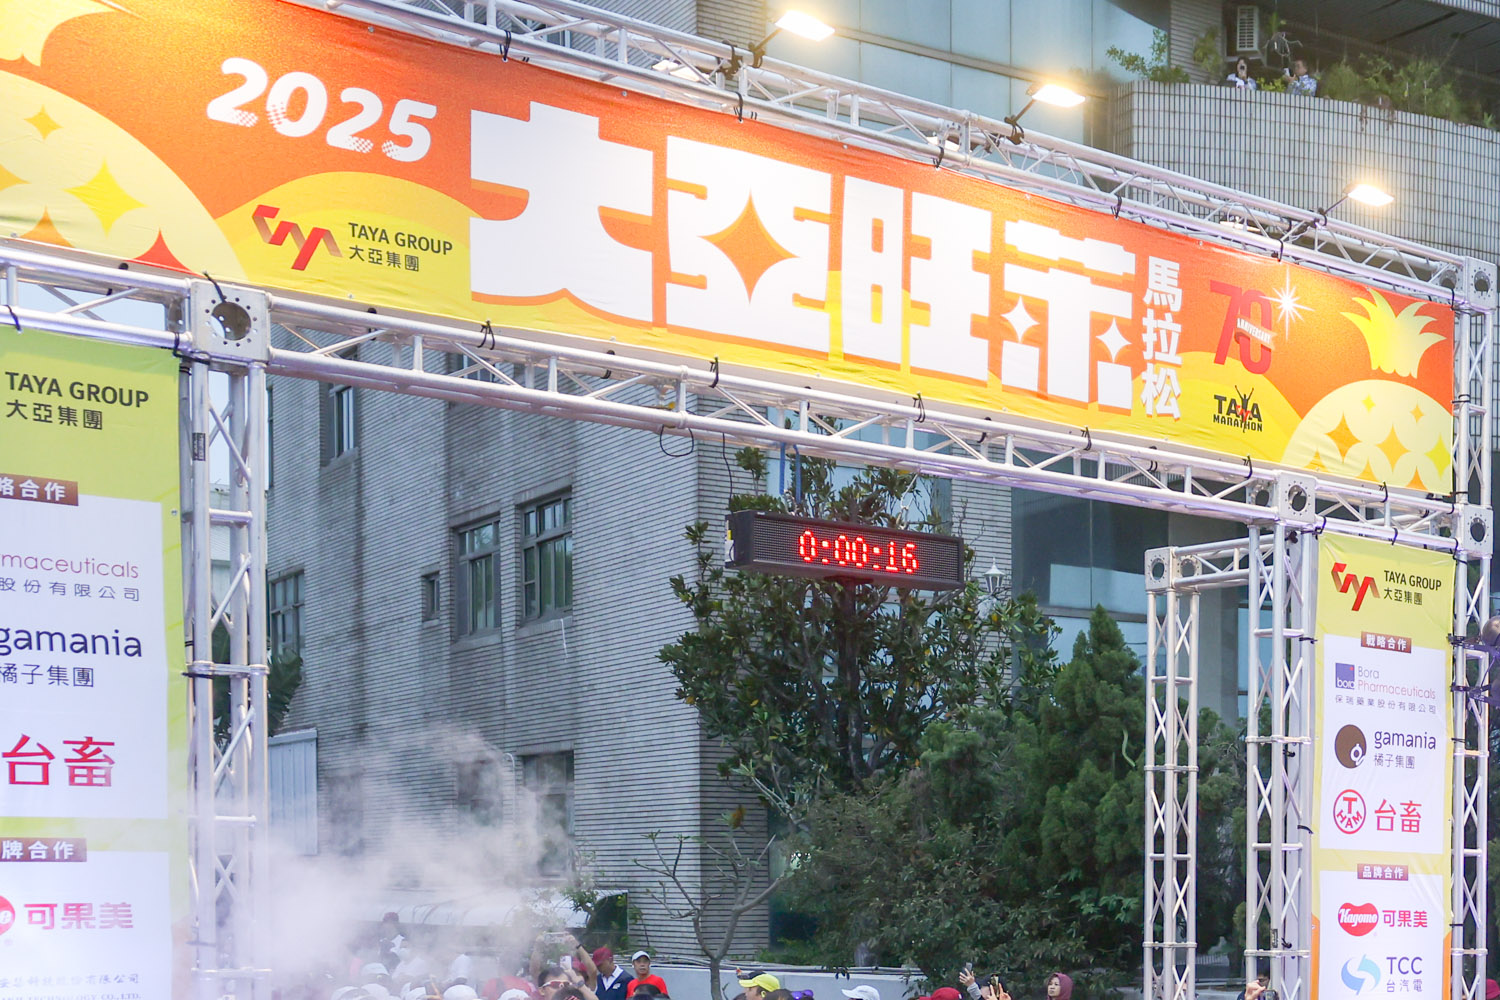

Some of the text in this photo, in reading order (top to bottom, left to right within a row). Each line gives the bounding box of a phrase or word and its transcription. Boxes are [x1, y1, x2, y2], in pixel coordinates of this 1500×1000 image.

[207, 57, 437, 163] 2025
[348, 222, 453, 257] TAYA GROUP
[348, 244, 420, 272] 大亞集團
[1140, 255, 1183, 421] 馬拉松
[1210, 279, 1272, 375] 70
[5, 371, 149, 408] TAYA GROUP
[6, 400, 103, 430] 大亞集團
[1213, 414, 1263, 432] MARATHON
[798, 530, 919, 574] 0:00:16
[1384, 570, 1442, 591] TAYA GROUP
[1384, 587, 1423, 605] 大亞集團
[0, 628, 142, 658] gamania
[1358, 666, 1379, 679] Bora
[1358, 680, 1435, 699] Pharmaceuticals
[1374, 730, 1436, 750] gamania
[2, 734, 117, 787] 台畜
[1375, 799, 1422, 833] 台畜
[1362, 866, 1403, 879] 品牌合作
[24, 902, 134, 930] 可果美
[1382, 910, 1428, 927] 可果美
[1387, 956, 1422, 975] TCC
[1387, 979, 1423, 993] 台汽電
